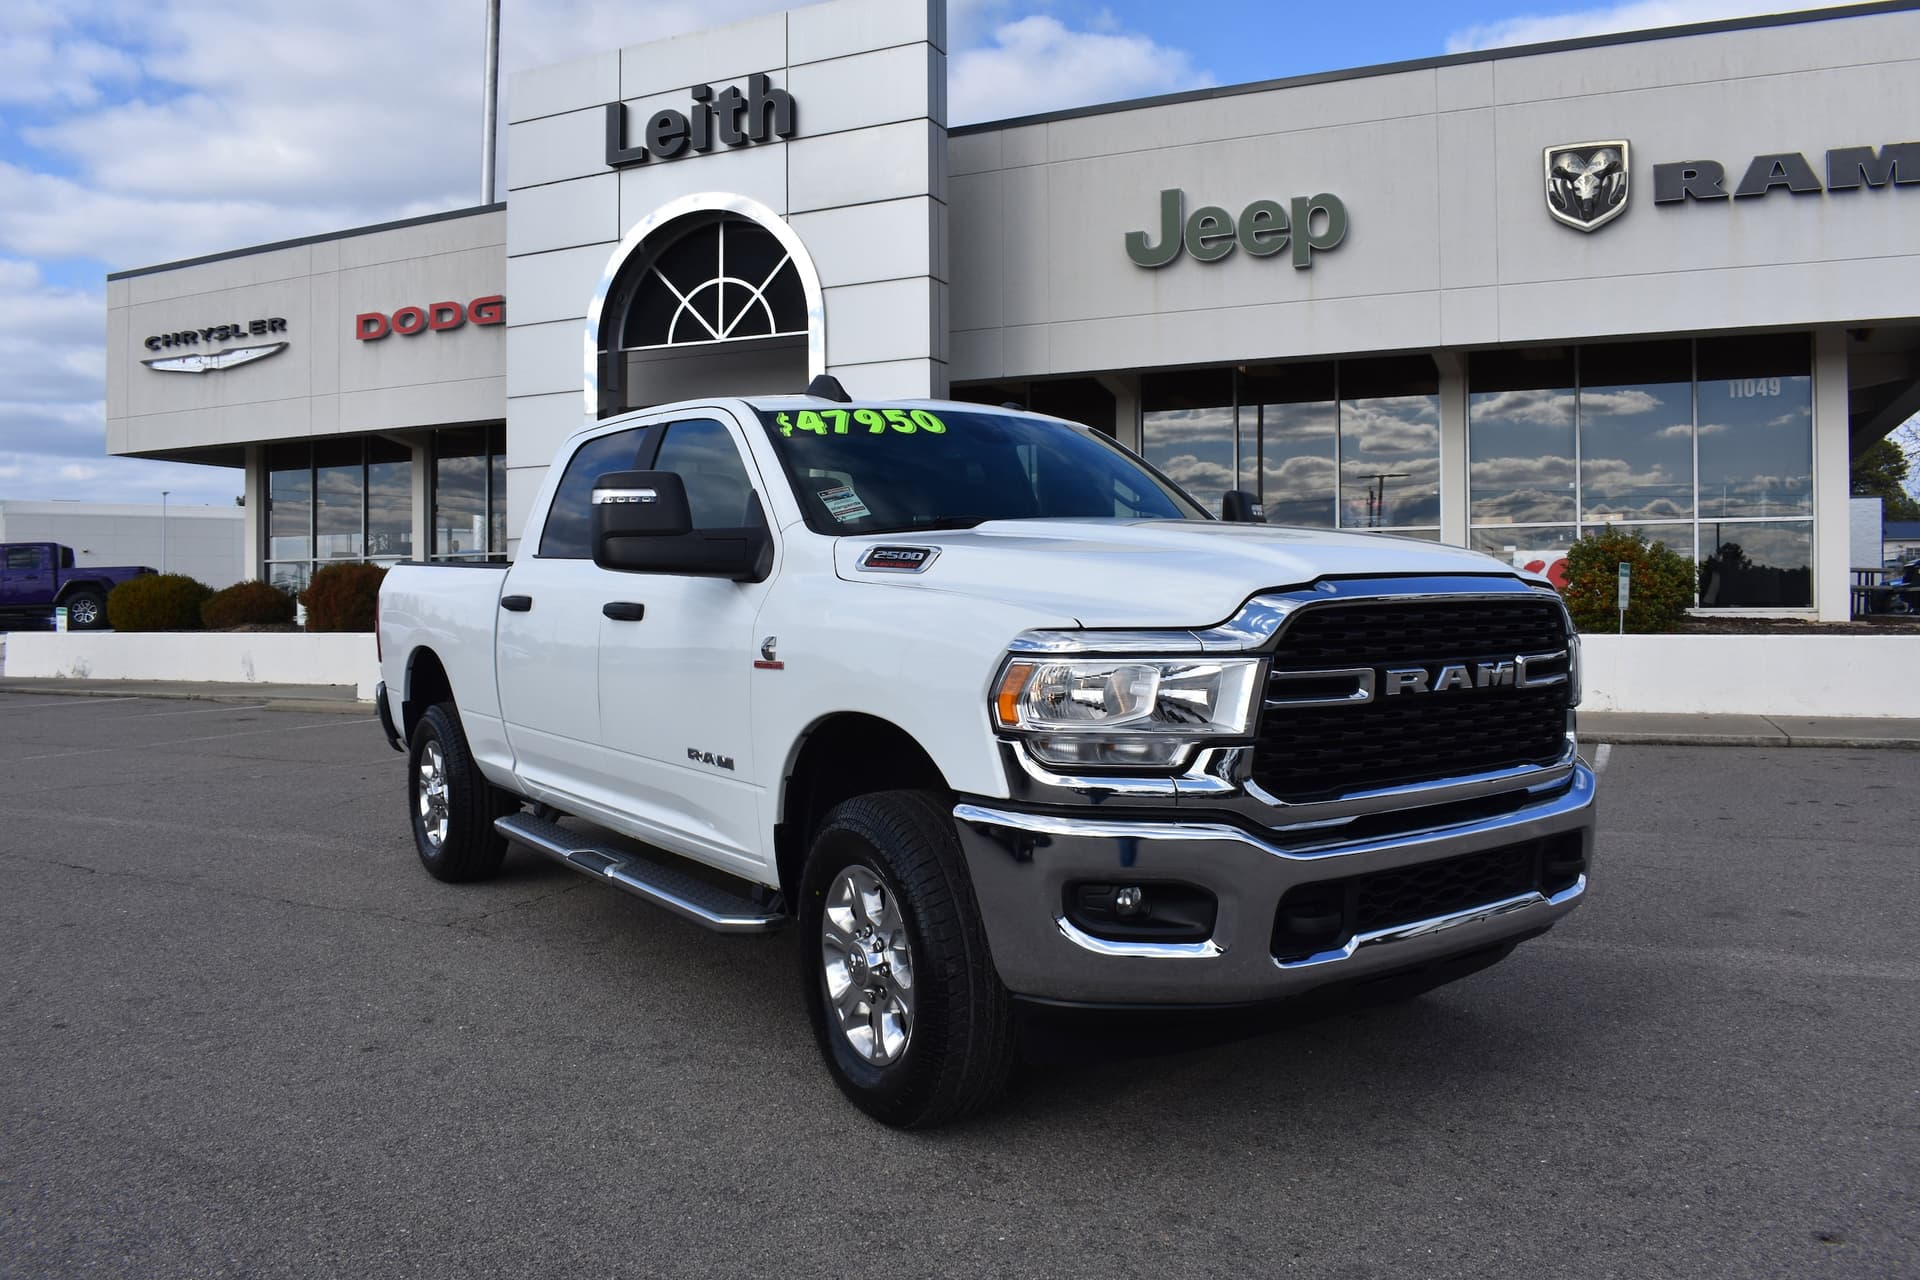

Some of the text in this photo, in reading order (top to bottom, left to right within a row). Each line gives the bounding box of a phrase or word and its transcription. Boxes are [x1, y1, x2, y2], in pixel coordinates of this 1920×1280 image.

[606, 72, 797, 168] Leith
[1652, 142, 1920, 206] RAM
[1125, 188, 1348, 270] Jeep
[144, 317, 288, 351] CHRYSLER
[1728, 377, 1781, 399] 11049
[776, 409, 947, 437] $47950
[874, 550, 925, 561] 2500
[1386, 660, 1515, 696] RAM
[687, 747, 736, 771] RAM
